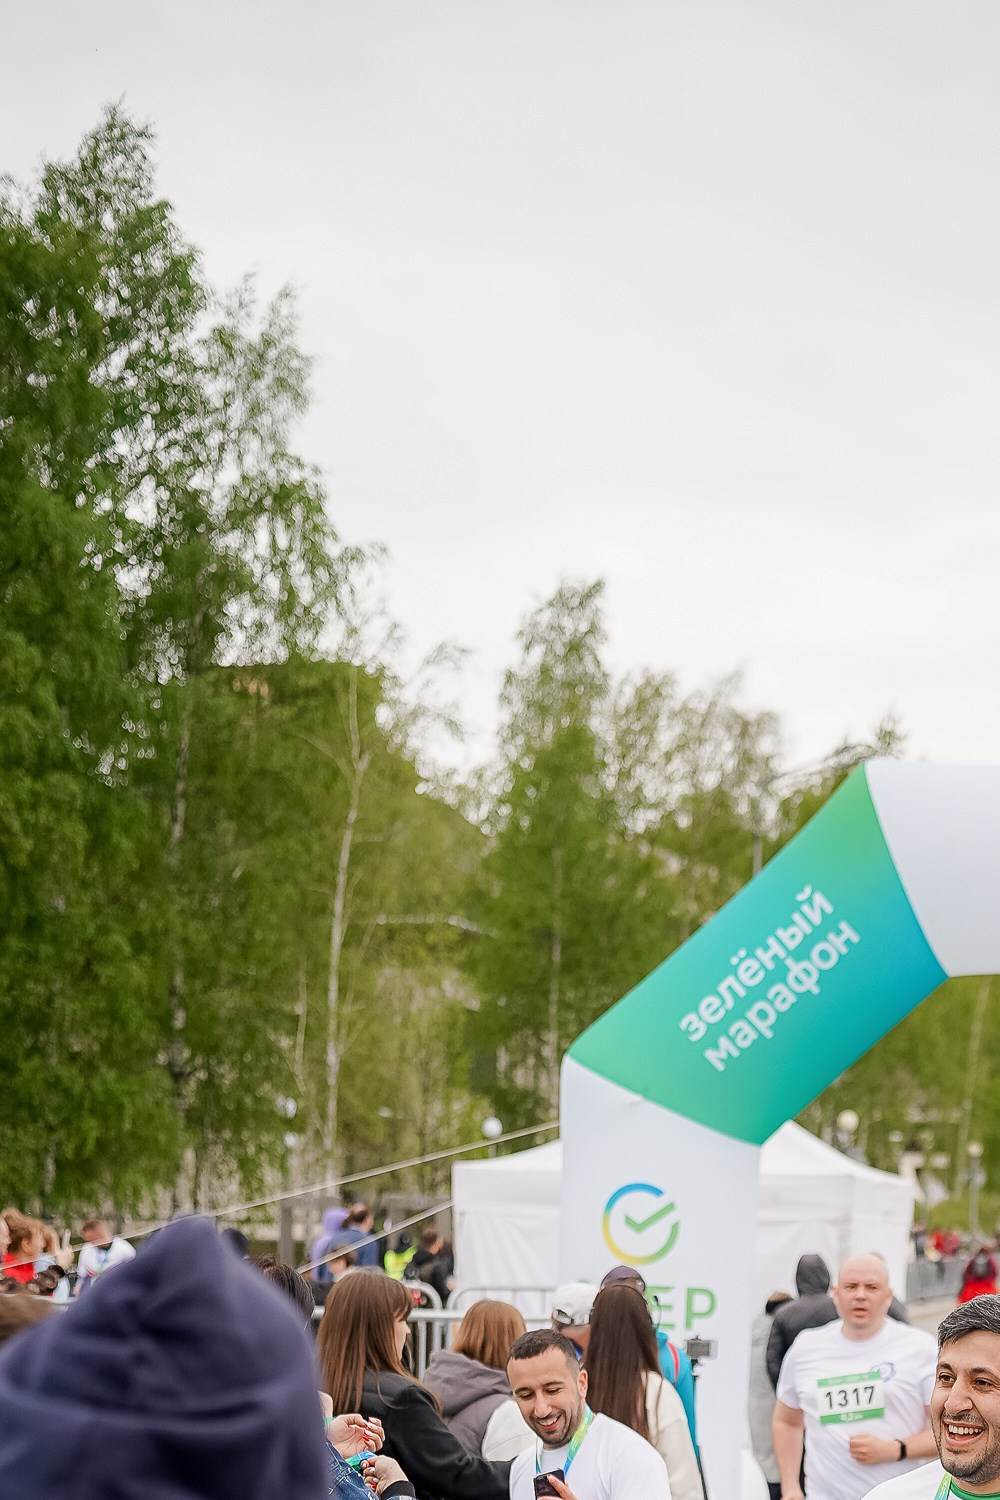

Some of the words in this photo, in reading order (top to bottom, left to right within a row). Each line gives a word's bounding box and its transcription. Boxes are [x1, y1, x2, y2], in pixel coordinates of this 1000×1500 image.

[678, 884, 835, 1043] зелёный
[702, 919, 861, 1073] марафон
[825, 1385, 876, 1410] 1317
